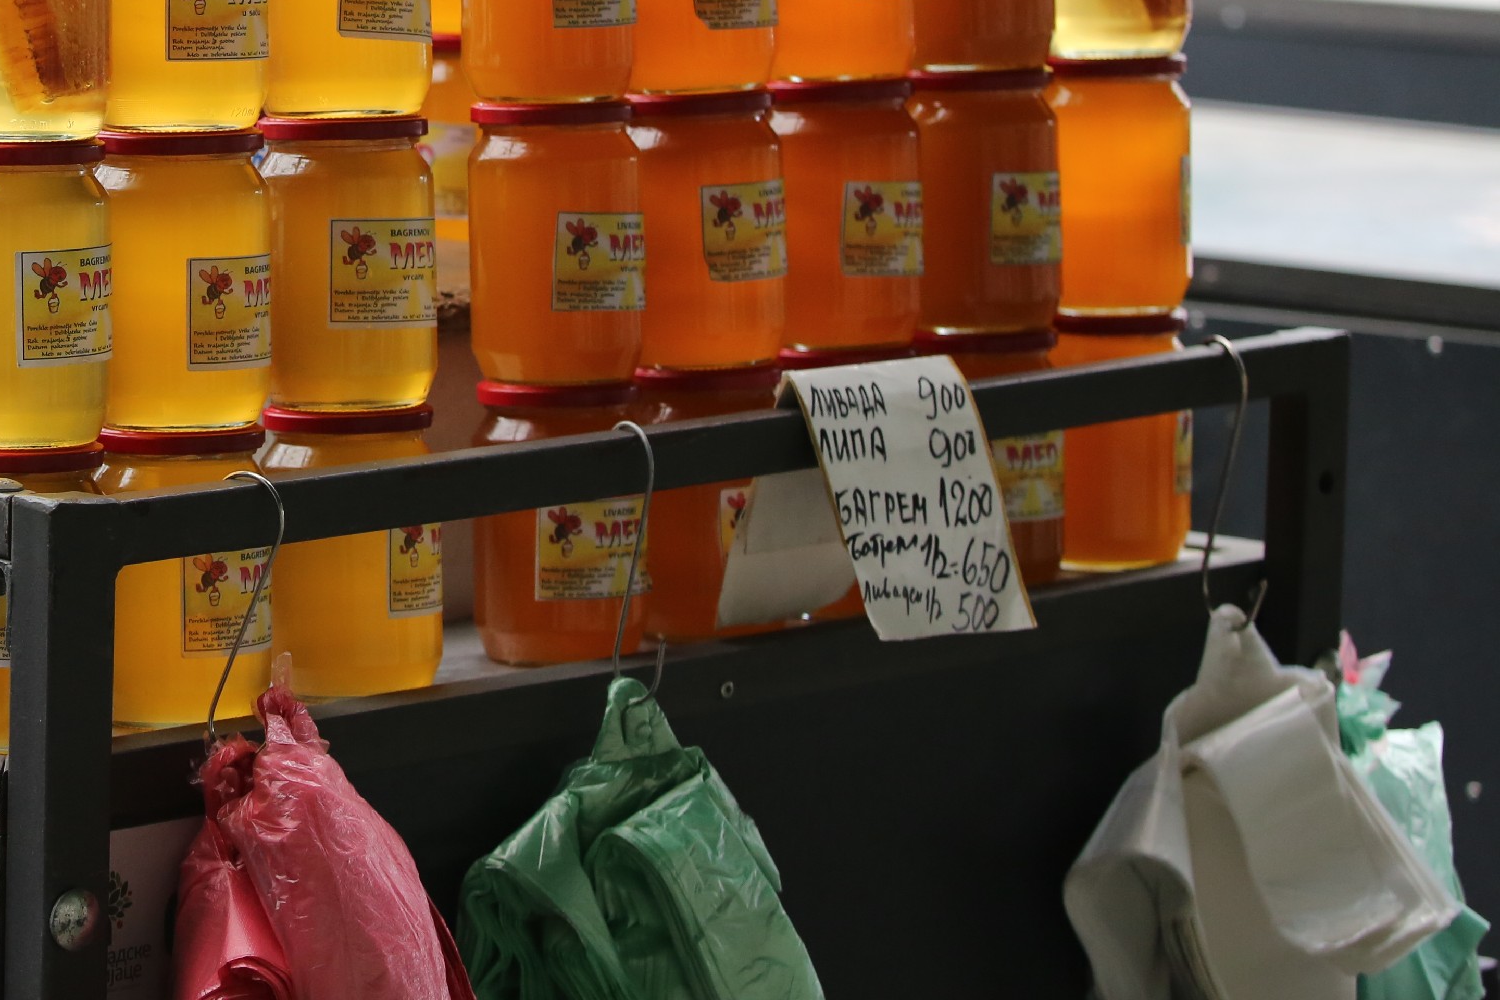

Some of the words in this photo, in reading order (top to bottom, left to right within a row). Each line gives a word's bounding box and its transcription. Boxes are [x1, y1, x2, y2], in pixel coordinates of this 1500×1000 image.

[752, 198, 785, 229] ME
[79, 268, 112, 301] ME
[244, 277, 271, 308] ME
[810, 382, 887, 421] ЛИВАДА
[918, 375, 966, 420] 900
[820, 426, 887, 463] ЛИПА
[835, 489, 928, 526] БАГРЕМ
[939, 476, 992, 528] 1200
[952, 593, 999, 631] 500
